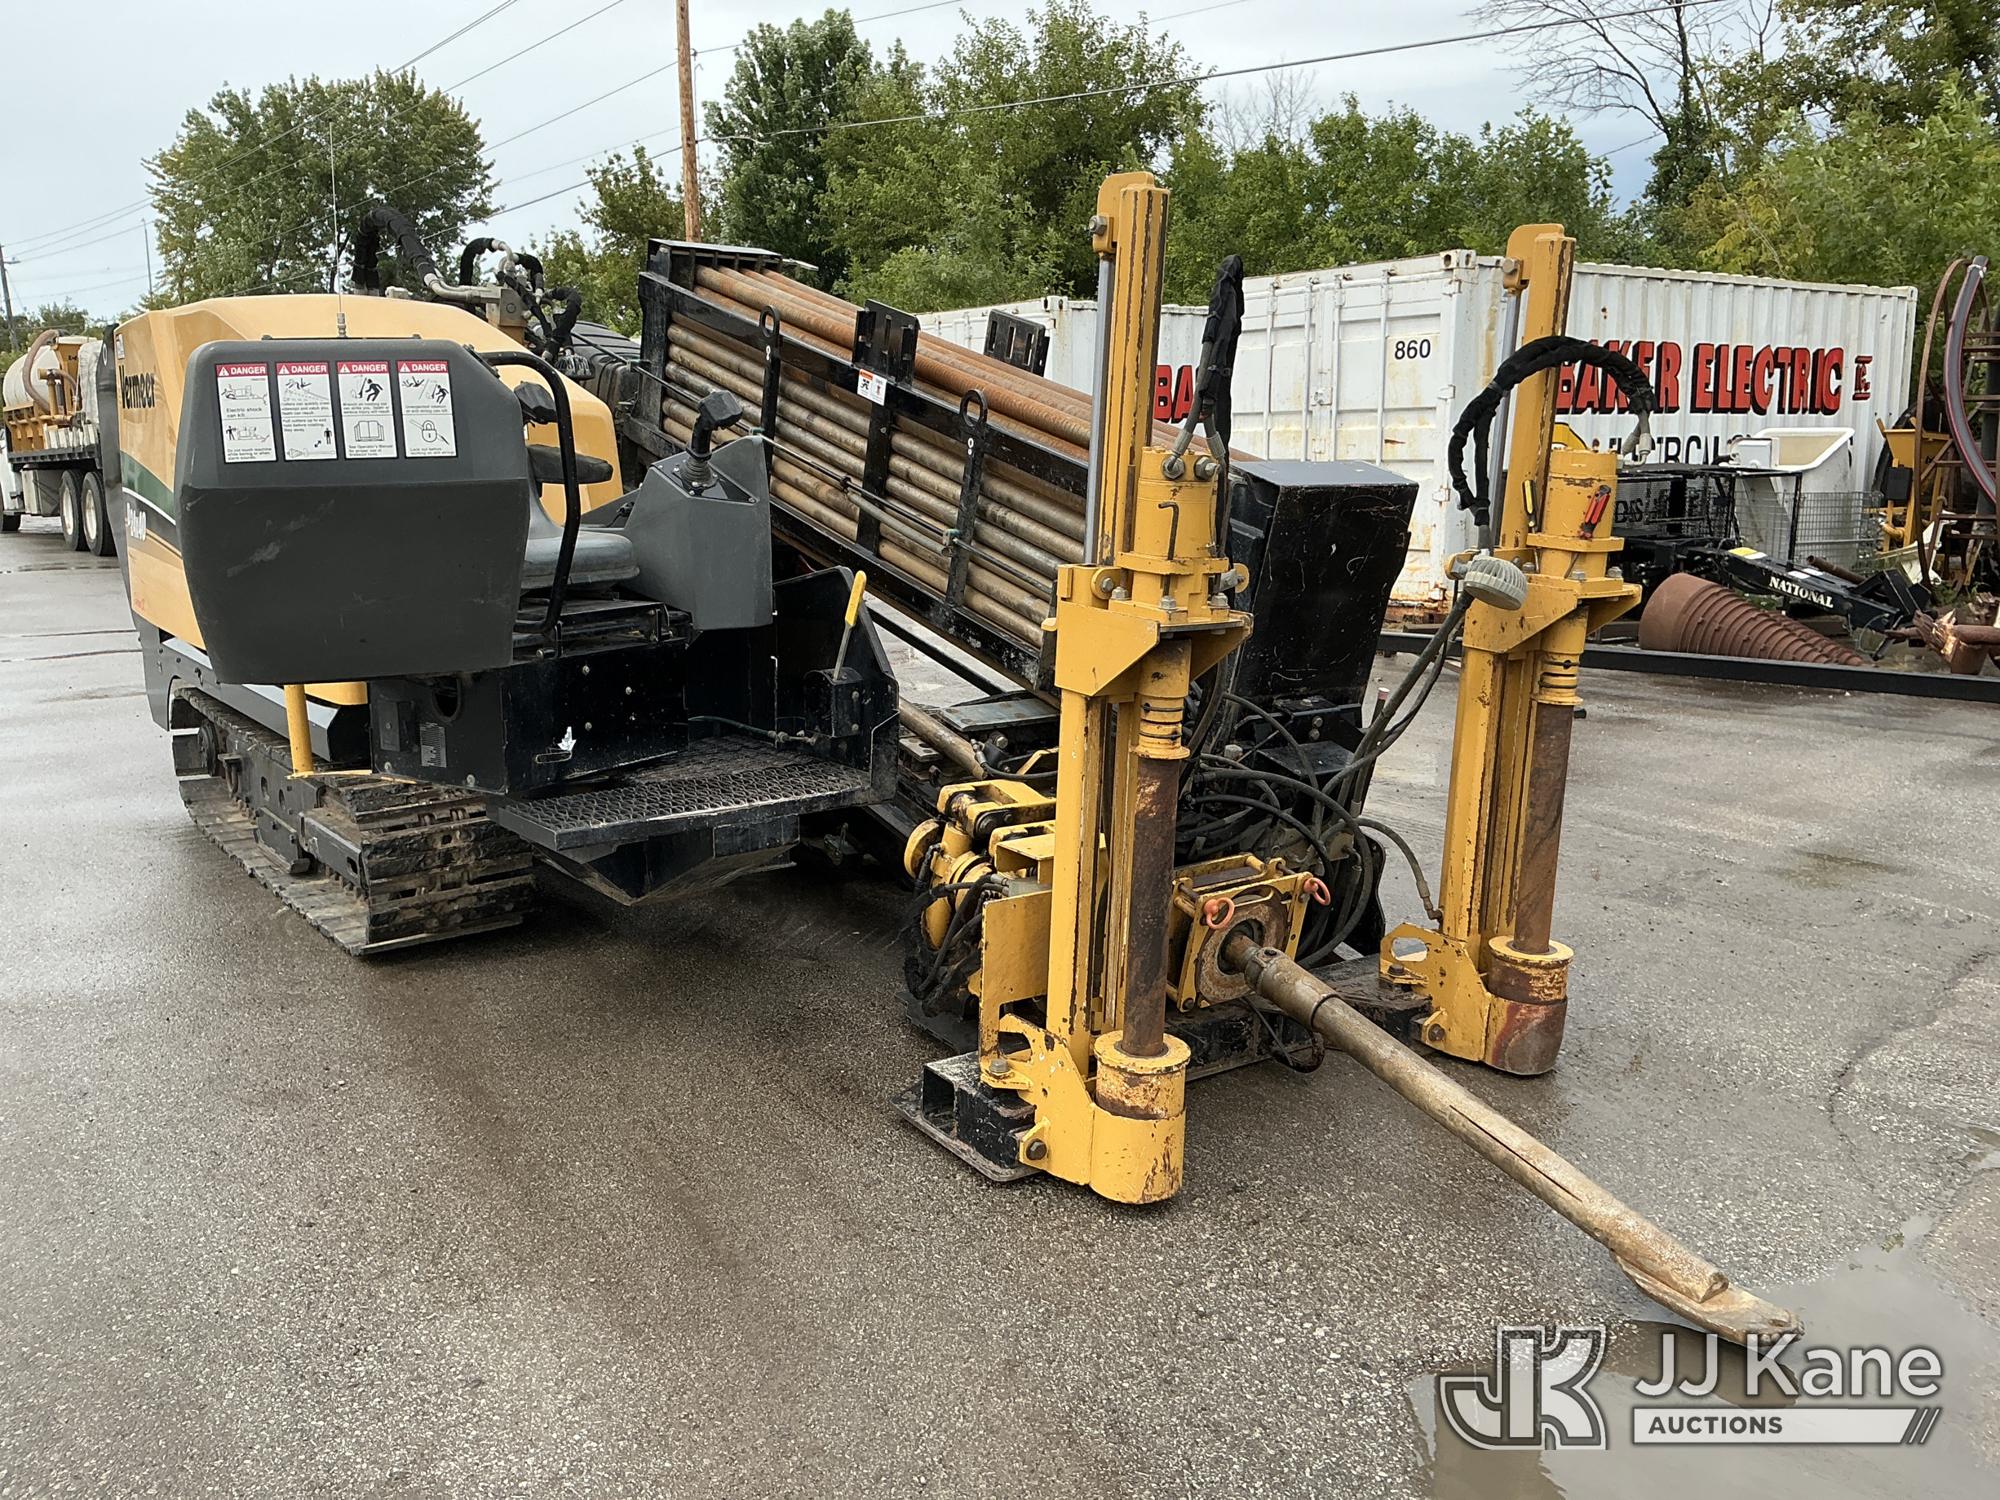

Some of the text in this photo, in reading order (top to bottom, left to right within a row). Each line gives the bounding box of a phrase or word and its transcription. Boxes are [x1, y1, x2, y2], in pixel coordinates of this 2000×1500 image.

[1394, 339, 1431, 360] 860
[230, 366, 266, 375] DANGER
[291, 365, 327, 373] DANGER
[351, 364, 387, 372] DANGER
[411, 363, 447, 371] DANGER
[118, 364, 155, 409] Vermeer
[1689, 343, 1844, 415] ELECTRIC
[1768, 576, 1834, 608] NATIONAL
